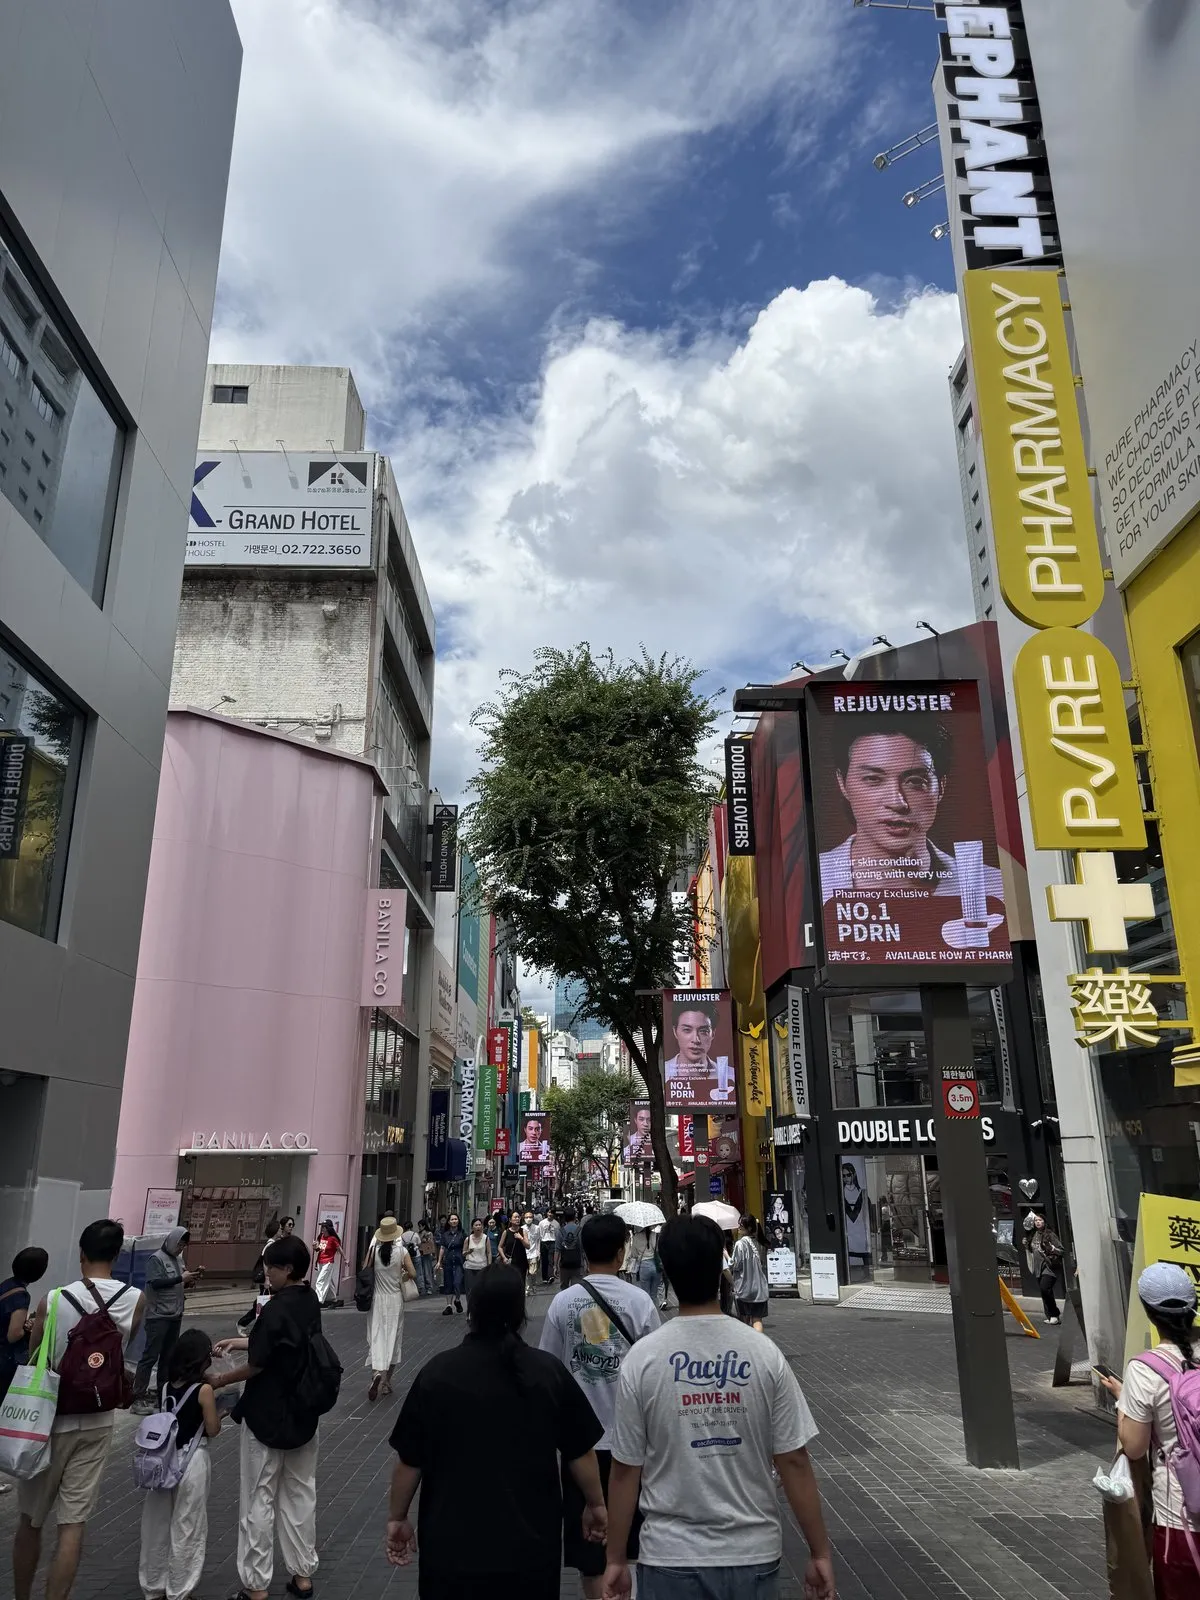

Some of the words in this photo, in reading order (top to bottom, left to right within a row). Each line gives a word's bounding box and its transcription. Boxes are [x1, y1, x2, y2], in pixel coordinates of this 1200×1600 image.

[944, 0, 1044, 258] EPHANT
[1105, 427, 1133, 471] PURE
[1134, 339, 1198, 433] PHARMACY
[991, 282, 1083, 593] PHARMACY
[1108, 463, 1125, 491] WE
[1127, 402, 1174, 469] CHOOSE
[1175, 376, 1191, 413] BY
[1113, 488, 1127, 514] SO
[1128, 411, 1190, 492] DECISIONS
[1116, 501, 1137, 535] GET
[1139, 436, 1195, 507] FORMULA
[229, 510, 295, 530] GRAND
[301, 510, 361, 531] HOTEL
[1118, 525, 1142, 558] FOR
[1142, 485, 1176, 529] YOUR
[730, 745, 747, 795] DOUBLE
[733, 797, 749, 848] LOVERS
[440, 859, 448, 884] HOTEL
[858, 856, 877, 866] skin
[878, 856, 923, 867] condition
[884, 869, 905, 879] with
[907, 870, 933, 880] every
[936, 870, 953, 879] use
[835, 889, 881, 899] Pharmacy
[884, 889, 929, 898] Exclusive
[836, 902, 890, 921] NO.1
[375, 898, 391, 963] BANILA
[838, 923, 900, 942] PDRN
[885, 951, 936, 960] AVAILABLE
[939, 951, 962, 960] NOW
[965, 951, 976, 960] AT
[373, 970, 387, 997] CO
[672, 993, 720, 1002] REJUVUSTER
[791, 999, 801, 1049] DOUBLE
[1068, 967, 1162, 1050] 藥
[793, 1053, 805, 1105] LOVERS
[942, 1069, 974, 1080] 제한높이
[1001, 1036, 1011, 1097] LOVERS
[460, 1058, 475, 1145] PHARMACY
[483, 1068, 491, 1104] NATURE
[670, 1082, 691, 1090] NO.1
[670, 1090, 695, 1098] PDRN
[951, 1094, 972, 1102] 3.5m
[191, 1131, 273, 1150] BANILA
[280, 1131, 310, 1150] CO
[483, 1105, 491, 1145] REPUBLIC
[837, 1119, 911, 1143] DOUBLE
[1168, 1215, 1200, 1252] 藥
[572, 1349, 620, 1369] ANNOYED
[669, 1350, 751, 1389] Pacific
[0, 1404, 40, 1423] YOUNG
[682, 1392, 740, 1406] DRIVE-IN
